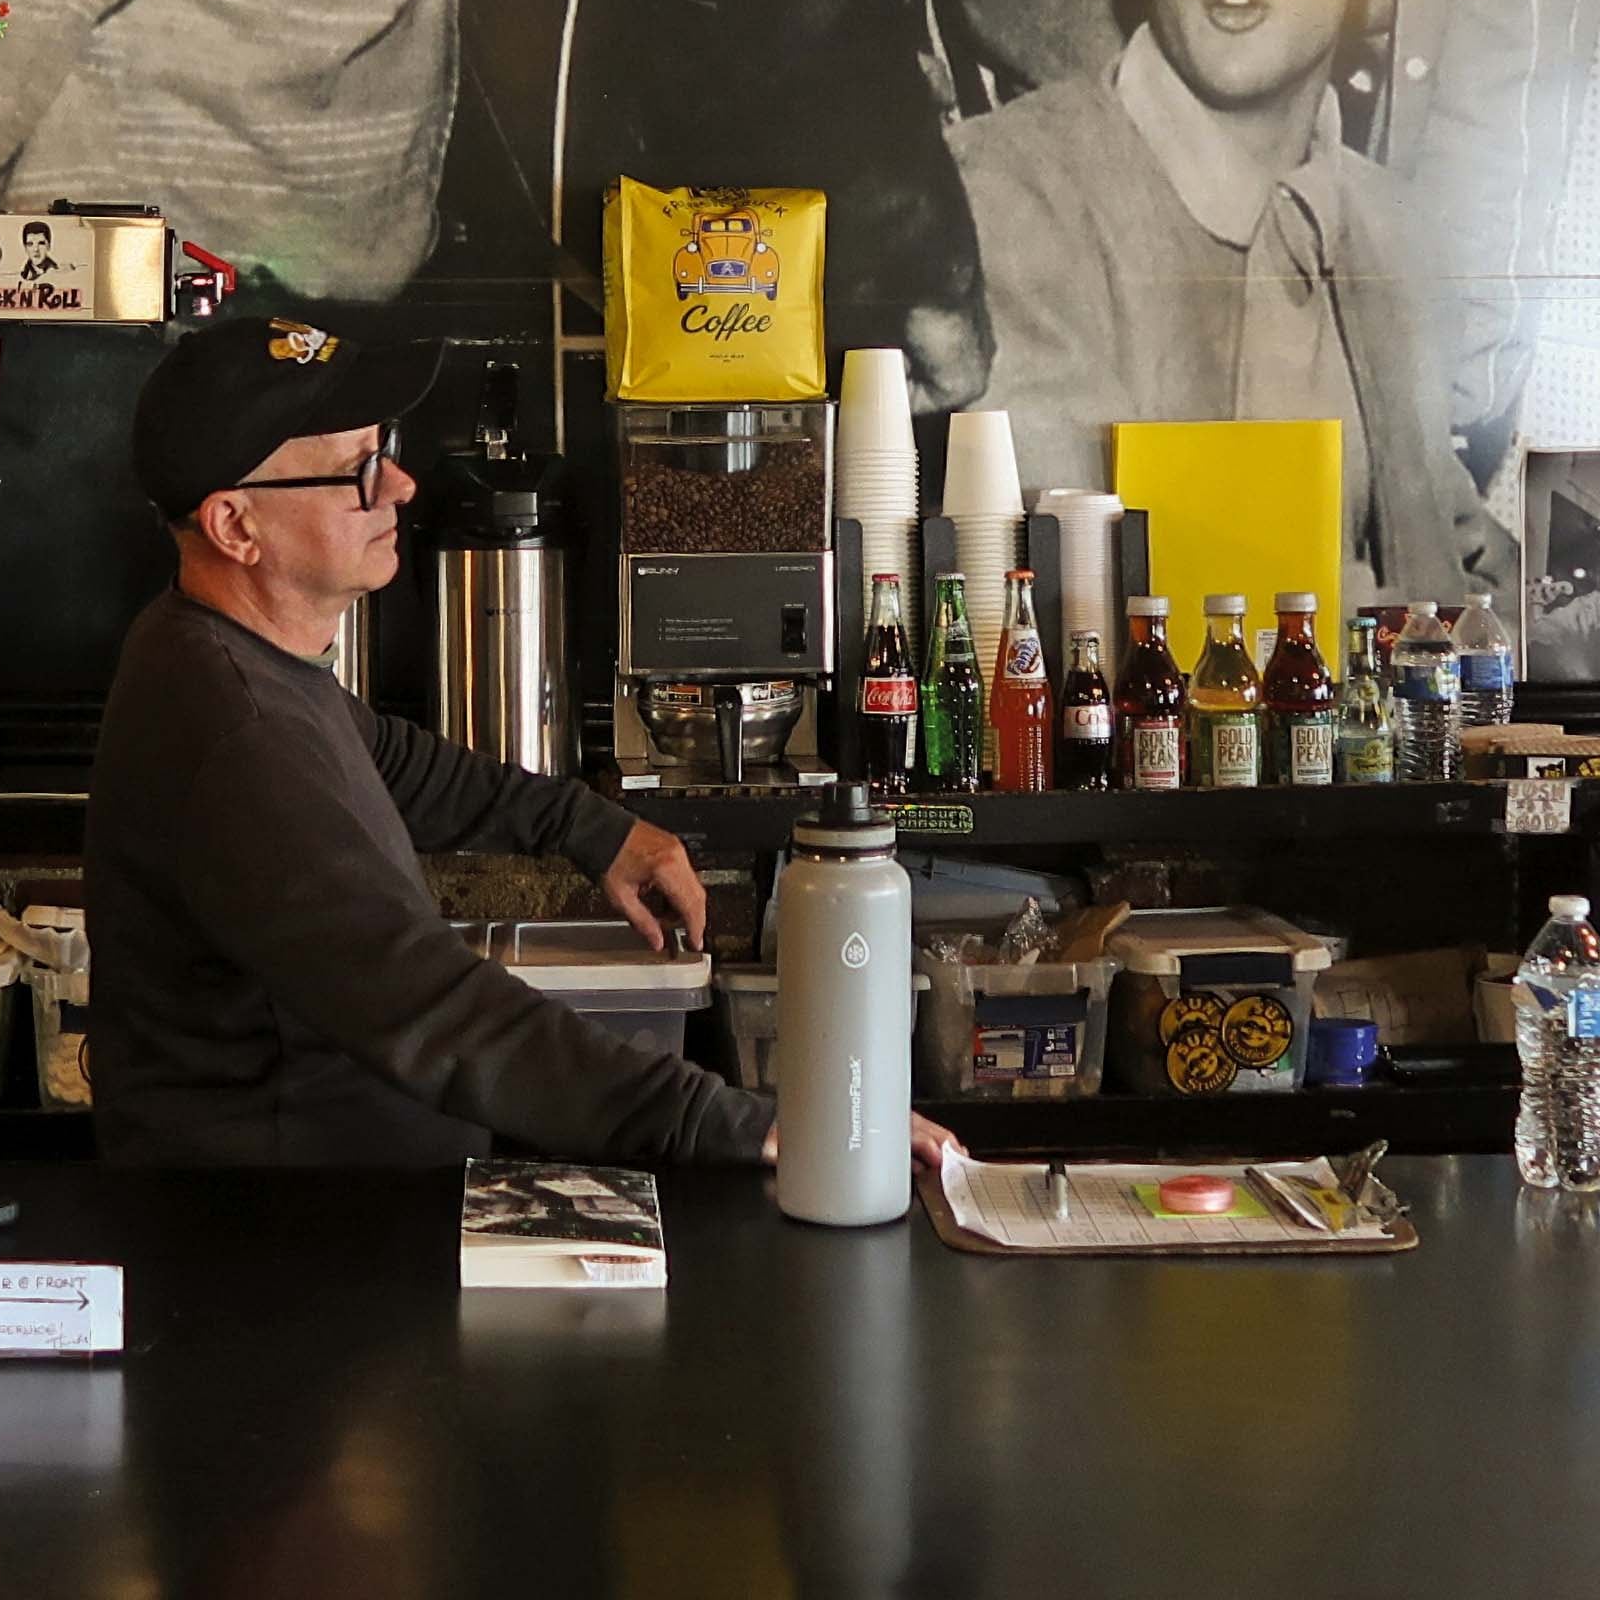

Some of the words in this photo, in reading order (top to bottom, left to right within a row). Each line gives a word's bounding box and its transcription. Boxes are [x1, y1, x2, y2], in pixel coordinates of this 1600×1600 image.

[681, 303, 774, 342] Coffee
[1217, 728, 1253, 746] GOLD
[35, 1276, 88, 1290] FRONT
